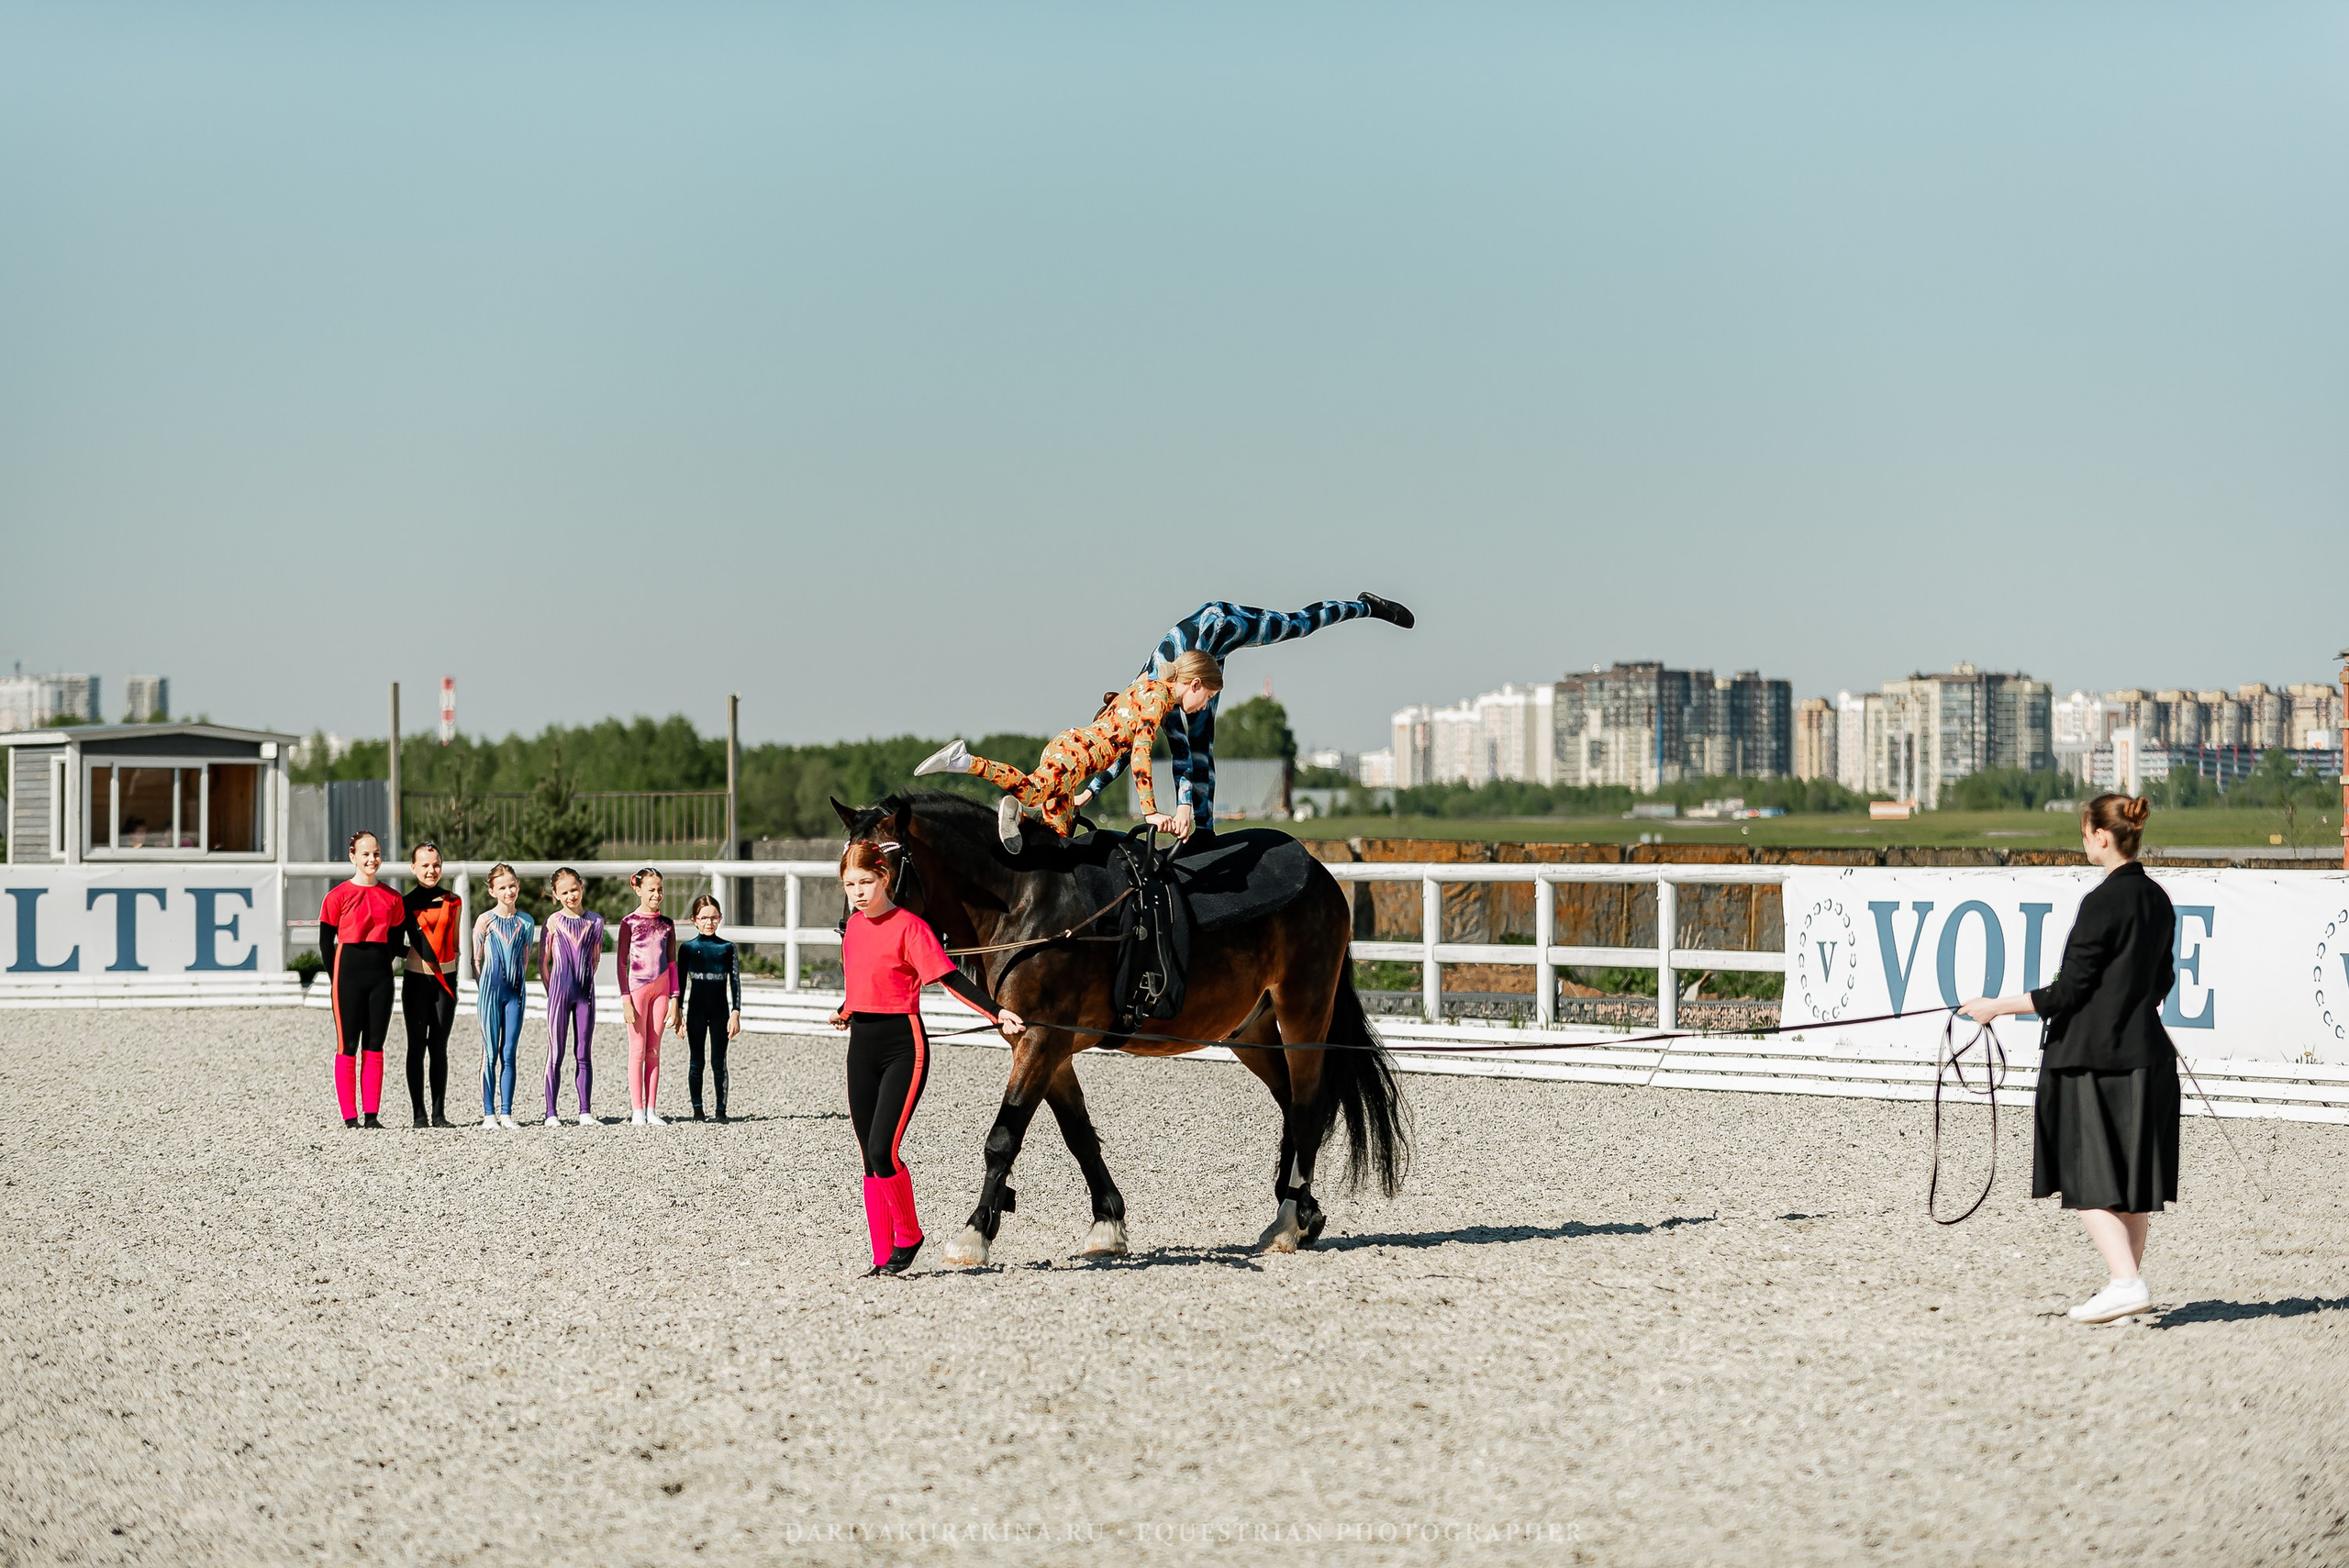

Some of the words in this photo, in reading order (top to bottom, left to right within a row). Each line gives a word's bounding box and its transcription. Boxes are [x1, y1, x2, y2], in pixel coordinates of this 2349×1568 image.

[5, 887, 258, 973] LTE
[1816, 941, 1838, 984] V
[1867, 899, 2215, 1029] VOLE
